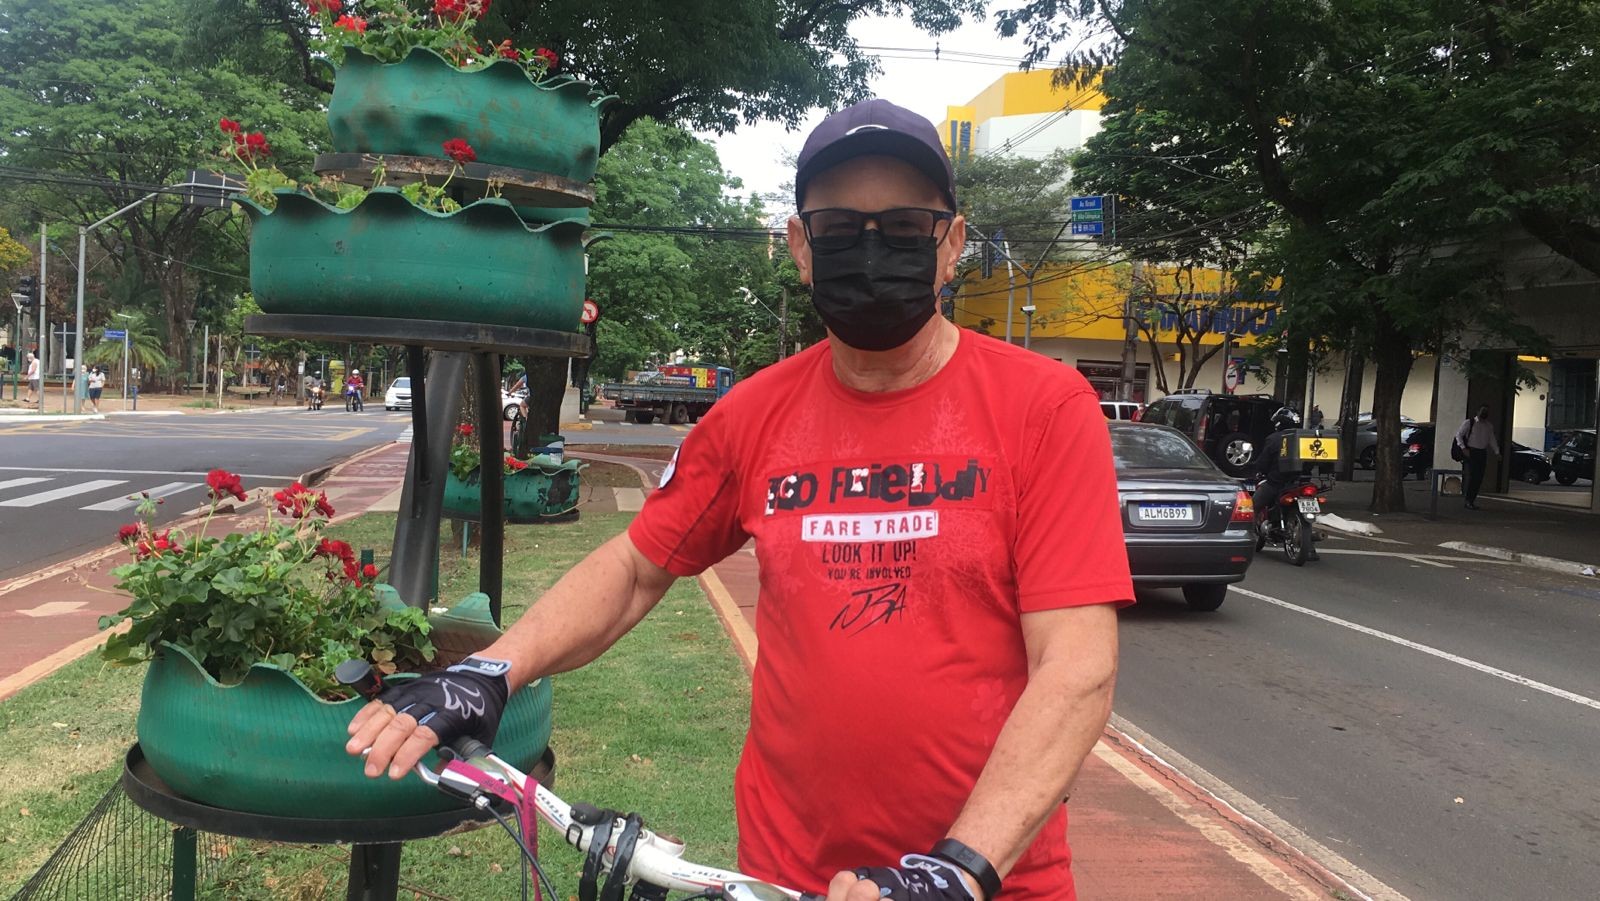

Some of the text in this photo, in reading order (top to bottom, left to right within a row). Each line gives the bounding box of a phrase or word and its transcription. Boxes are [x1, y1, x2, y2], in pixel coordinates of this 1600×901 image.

[1144, 508, 1188, 519] ALM6B99
[810, 515, 935, 536] FARE TRADE
[821, 541, 917, 563] LOOK IT UP!
[866, 566, 912, 580] INVOLVED
